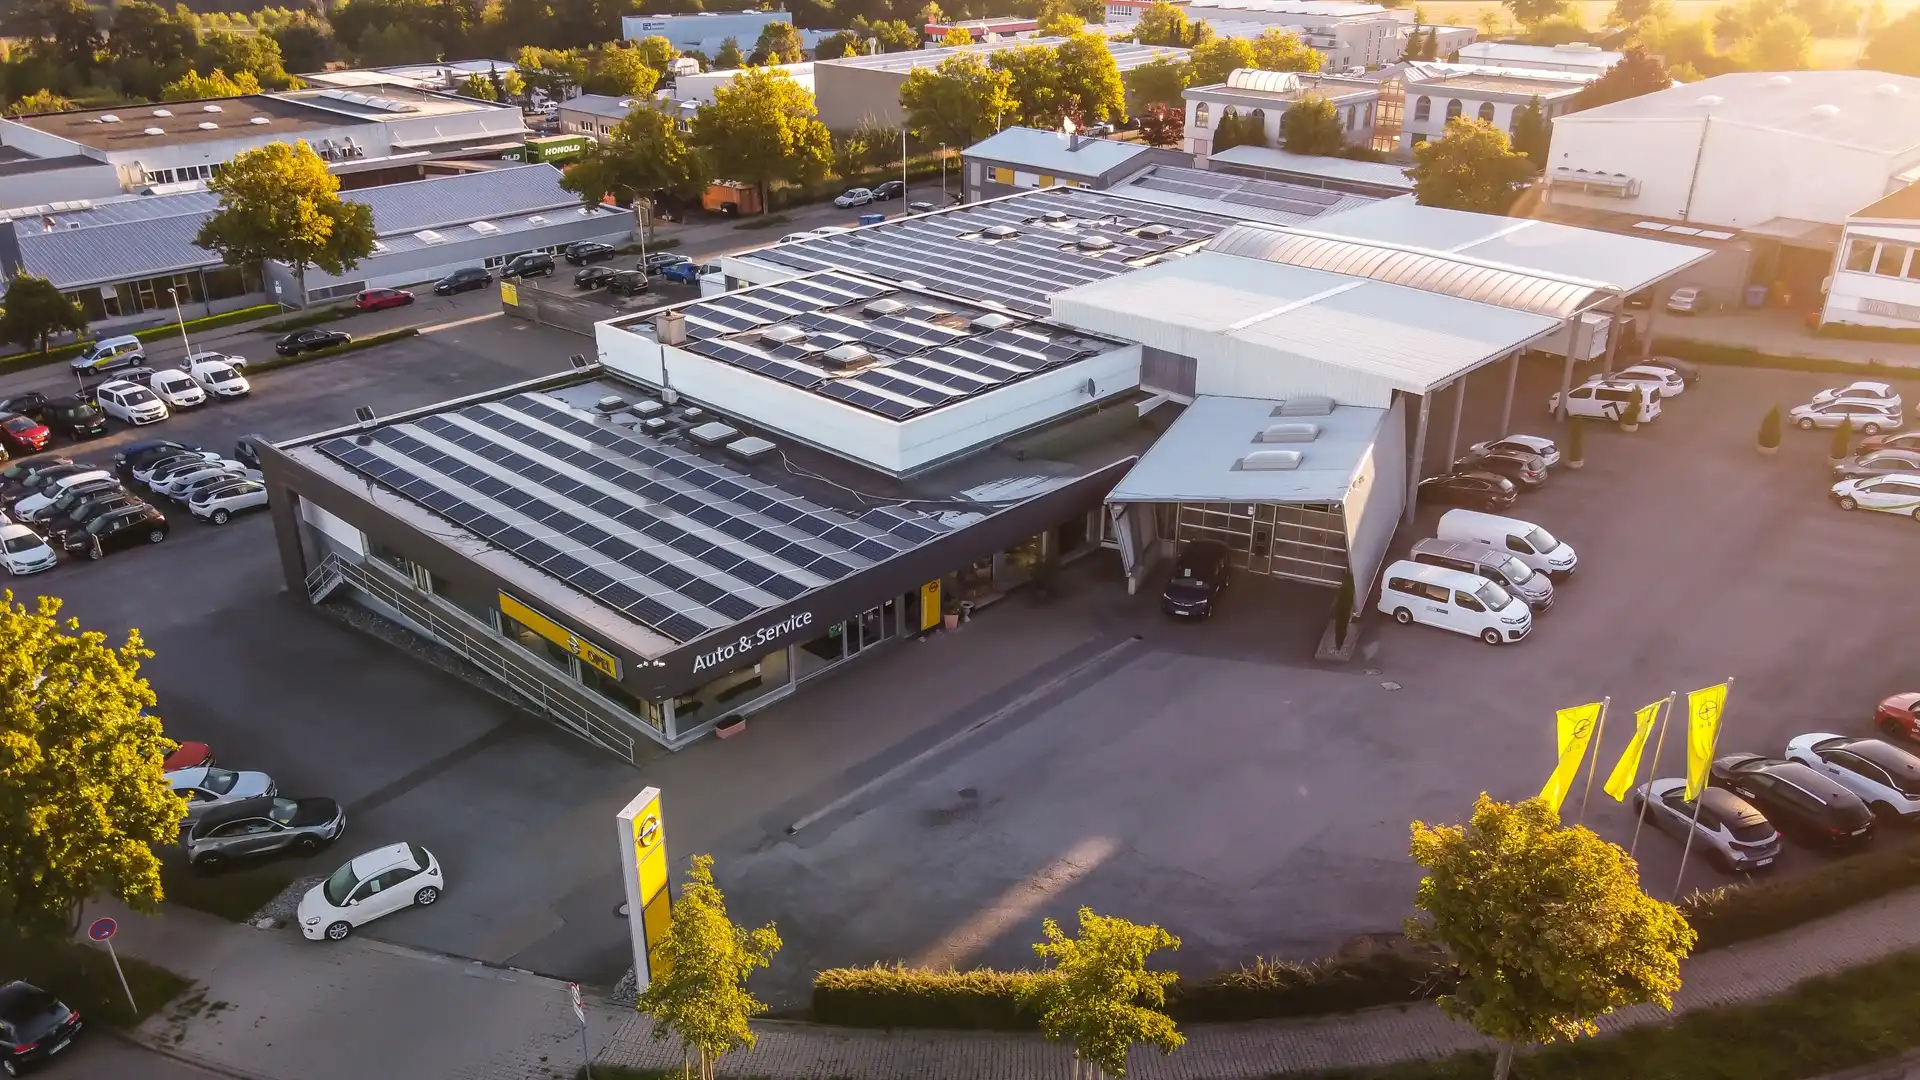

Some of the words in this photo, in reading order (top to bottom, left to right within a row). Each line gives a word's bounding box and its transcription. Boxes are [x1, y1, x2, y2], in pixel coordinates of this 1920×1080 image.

[545, 144, 580, 156] HONOLD
[693, 645, 735, 674] Auto
[739, 636, 752, 653] &
[756, 611, 812, 646] Service
